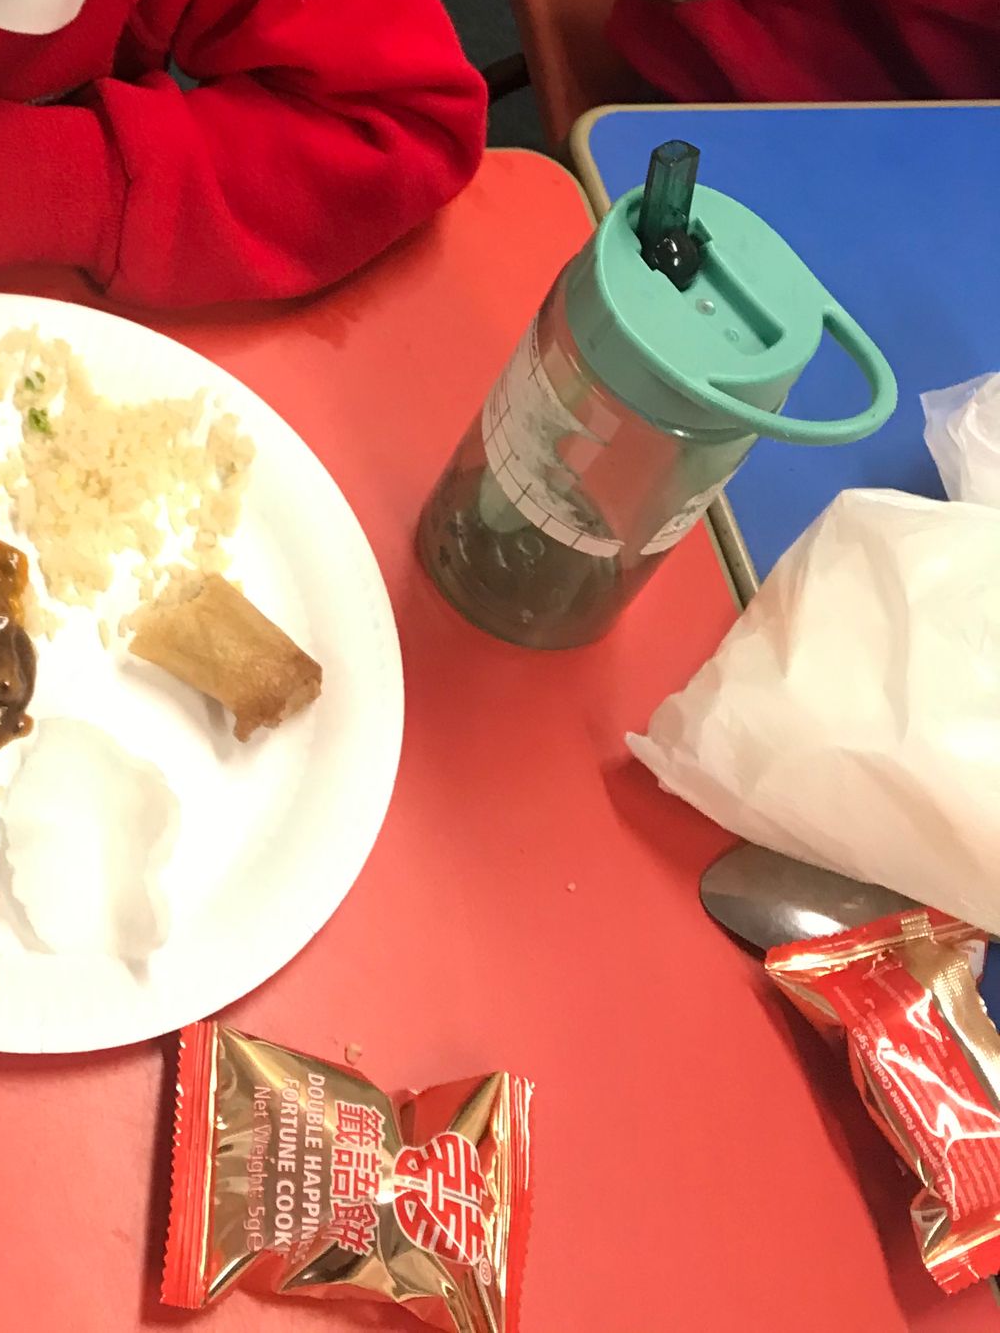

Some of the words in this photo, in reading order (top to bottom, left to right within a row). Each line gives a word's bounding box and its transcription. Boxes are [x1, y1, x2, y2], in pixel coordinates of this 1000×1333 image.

[866, 1044, 893, 1091] Cookies
[253, 1085, 272, 1119] Net
[277, 1077, 300, 1173] FORTUNE
[303, 1072, 326, 1149] DOUBLE
[889, 1089, 917, 1132] Fortune
[246, 1124, 273, 1198] Weight:
